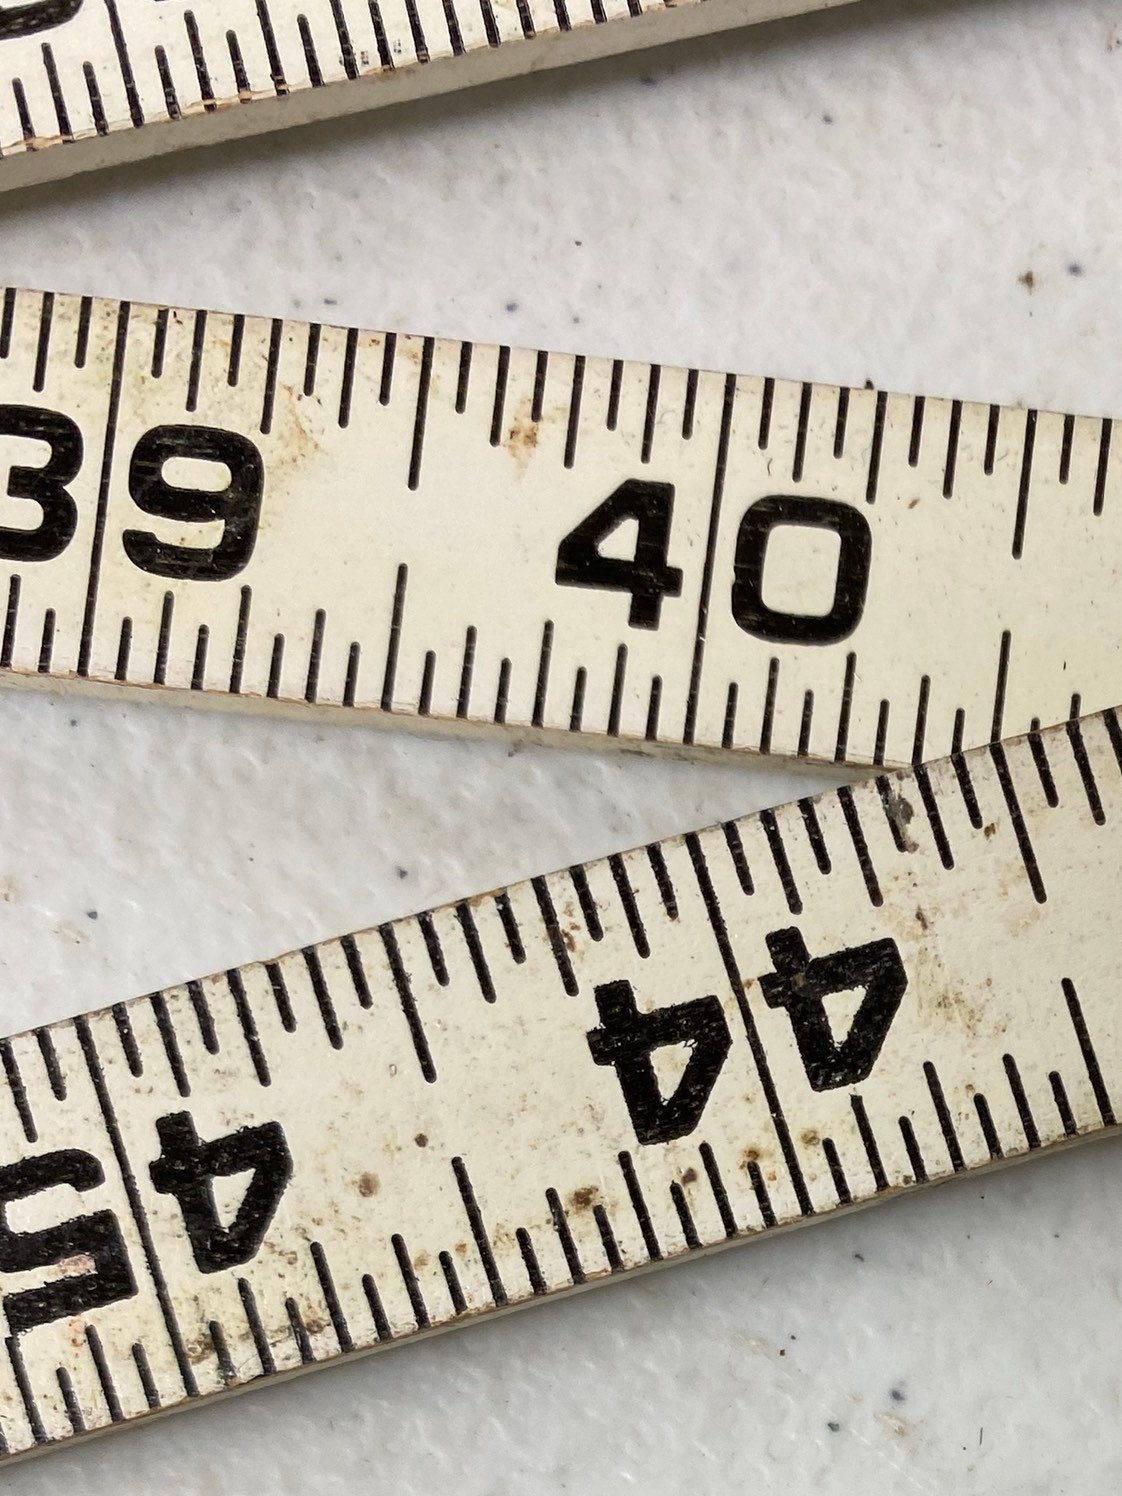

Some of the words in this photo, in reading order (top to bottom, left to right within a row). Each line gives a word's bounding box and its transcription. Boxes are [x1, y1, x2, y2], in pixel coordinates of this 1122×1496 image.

[0, 403, 265, 582] 39
[555, 478, 873, 646] 40
[586, 926, 908, 1146] 44
[0, 1110, 294, 1334] 45
